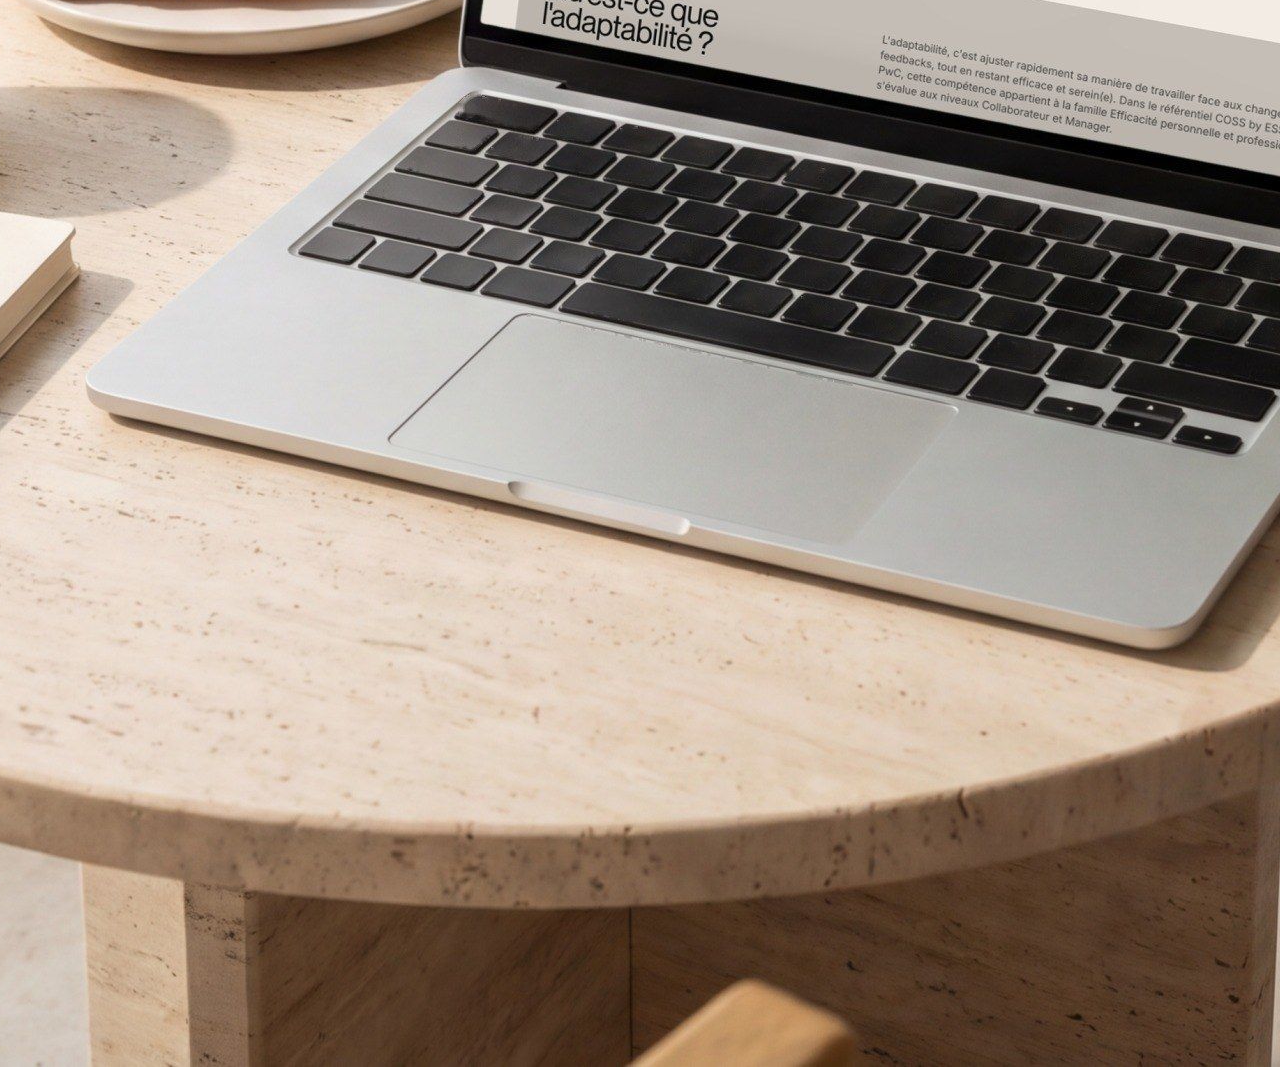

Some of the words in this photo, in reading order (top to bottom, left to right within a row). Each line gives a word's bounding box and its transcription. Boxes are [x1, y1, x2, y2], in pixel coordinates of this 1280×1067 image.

[670, 3, 719, 29] que
[698, 30, 714, 56] ?
[878, 65, 904, 80] PwC,
[906, 72, 932, 84] cette
[934, 77, 997, 96] compétence
[999, 90, 1051, 107] appartient
[1053, 98, 1060, 108] à
[1062, 99, 1072, 110] la
[1073, 101, 1108, 117] famille
[1109, 108, 1158, 127] Efficacité
[1160, 120, 1221, 139] personnelle
[1223, 132, 1235, 141] et
[880, 50, 934, 71] feedbacks,
[937, 61, 957, 74] tout
[959, 67, 973, 76] en
[974, 70, 1010, 84] restant
[1012, 76, 1054, 92] efficace
[1055, 85, 1066, 94] et
[1068, 87, 1116, 104] serein(e).
[1119, 95, 1146, 109] Dans
[1148, 100, 1158, 111] le
[1159, 104, 1213, 121] référentiel
[1215, 113, 1246, 128] COSS
[1248, 119, 1262, 133] by
[882, 35, 950, 58] L'adaptabilité,
[979, 54, 1015, 68] ajuster
[1016, 62, 1074, 80] rapidement
[1076, 73, 1089, 82] sa
[1091, 75, 1133, 90] manière
[1134, 83, 1148, 94] de
[1150, 86, 1196, 102] travailler
[1197, 93, 1221, 107] face
[1222, 100, 1243, 111] aux
[919, 90, 938, 100] aux
[940, 92, 979, 108] niveaux
[981, 100, 1050, 121] Collaborateur
[1052, 115, 1063, 125] et
[1065, 115, 1112, 134] Manager.
